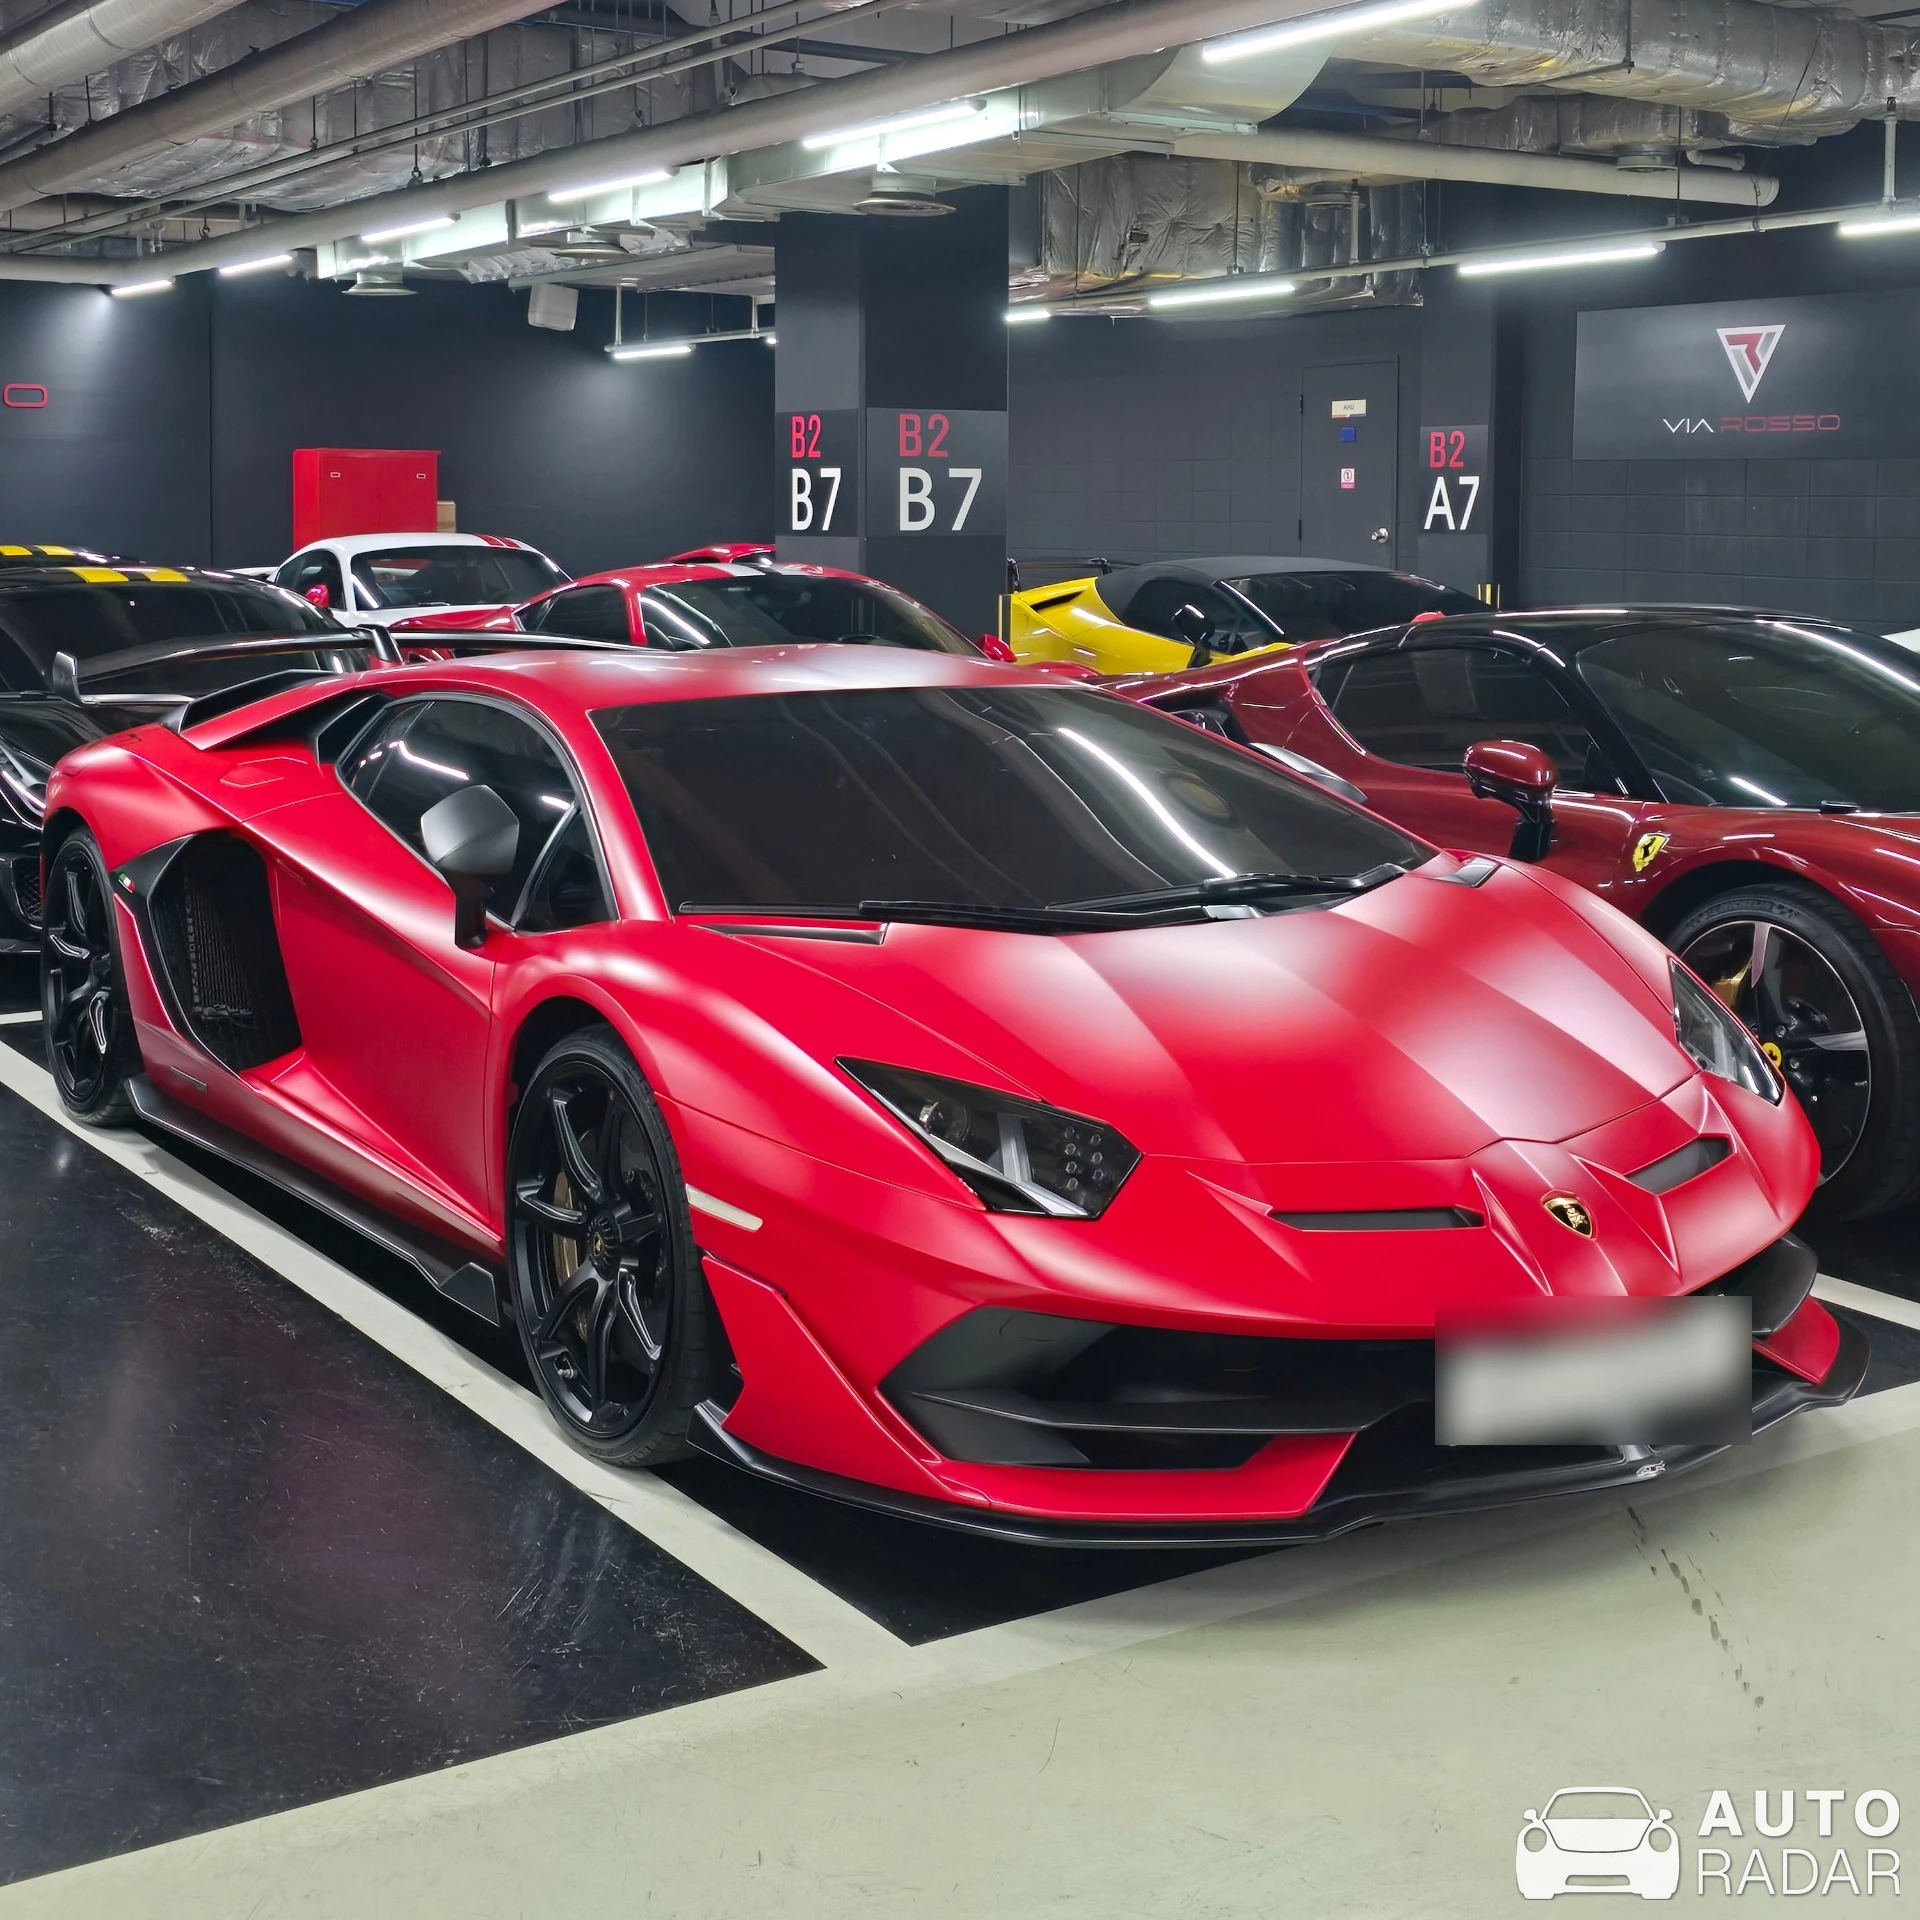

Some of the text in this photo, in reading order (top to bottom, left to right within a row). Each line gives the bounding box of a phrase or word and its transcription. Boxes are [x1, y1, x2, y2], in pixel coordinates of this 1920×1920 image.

[791, 415, 821, 458] B2
[899, 414, 948, 457] B2
[1663, 415, 1840, 433] VIA ROSSO
[1429, 430, 1465, 468] B2
[792, 468, 841, 530] B7
[900, 468, 981, 530] B7
[1424, 476, 1479, 530] A7
